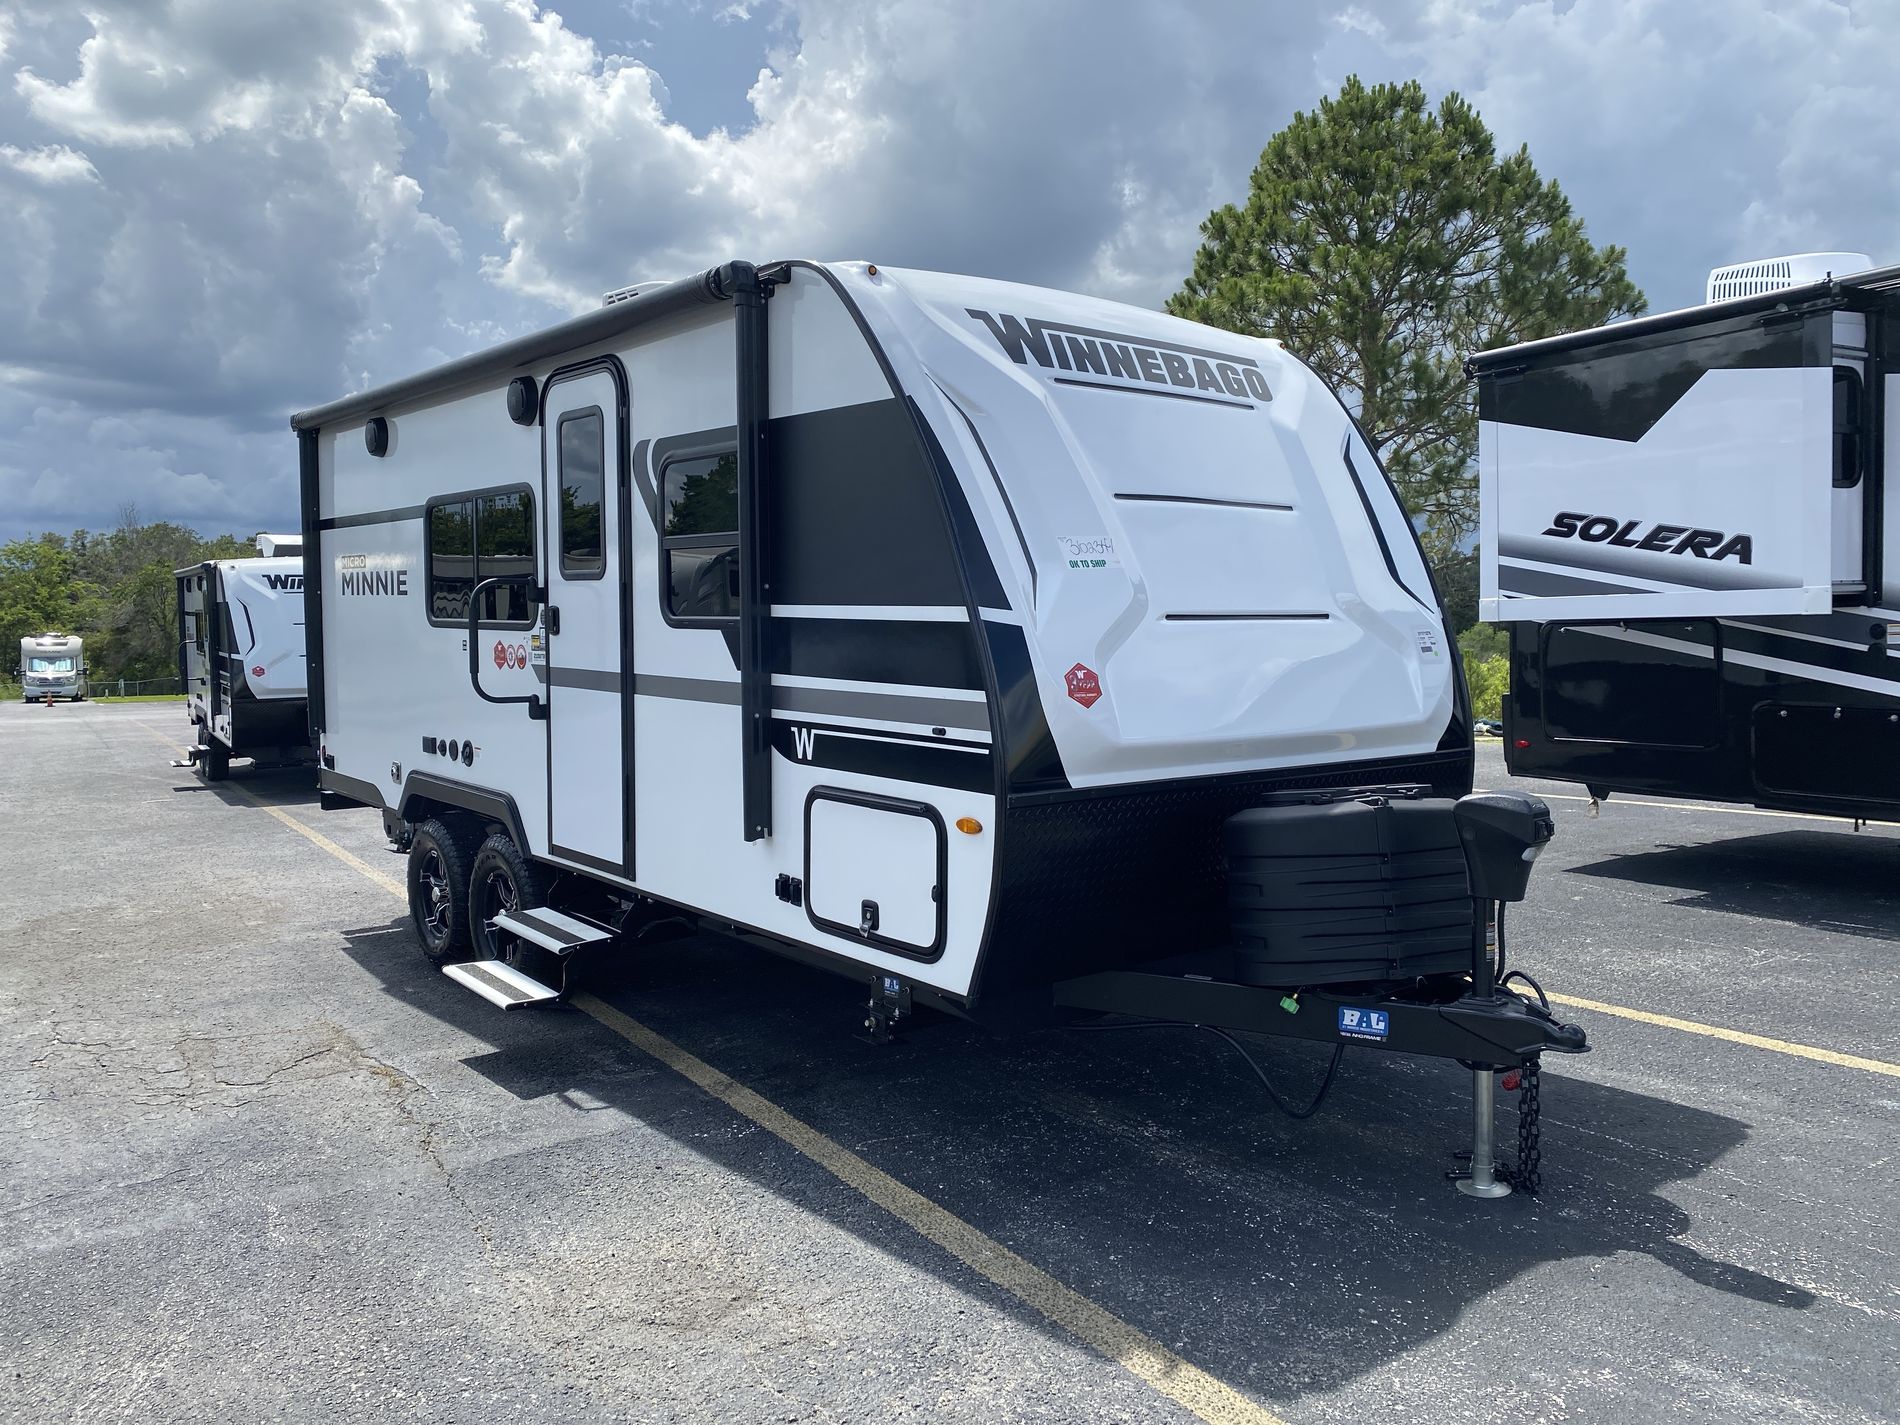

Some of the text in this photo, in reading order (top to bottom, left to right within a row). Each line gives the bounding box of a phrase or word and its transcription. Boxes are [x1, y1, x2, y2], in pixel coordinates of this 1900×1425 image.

[964, 308, 1273, 402] WINNEBAGO
[1541, 511, 1752, 565] SOLERA
[342, 556, 365, 568] MICRO
[1069, 560, 1080, 568] OK
[1080, 560, 1090, 568] TO
[1090, 559, 1106, 568] SHIP
[342, 570, 408, 596] MINNIE
[1343, 1009, 1385, 1029] BAL
